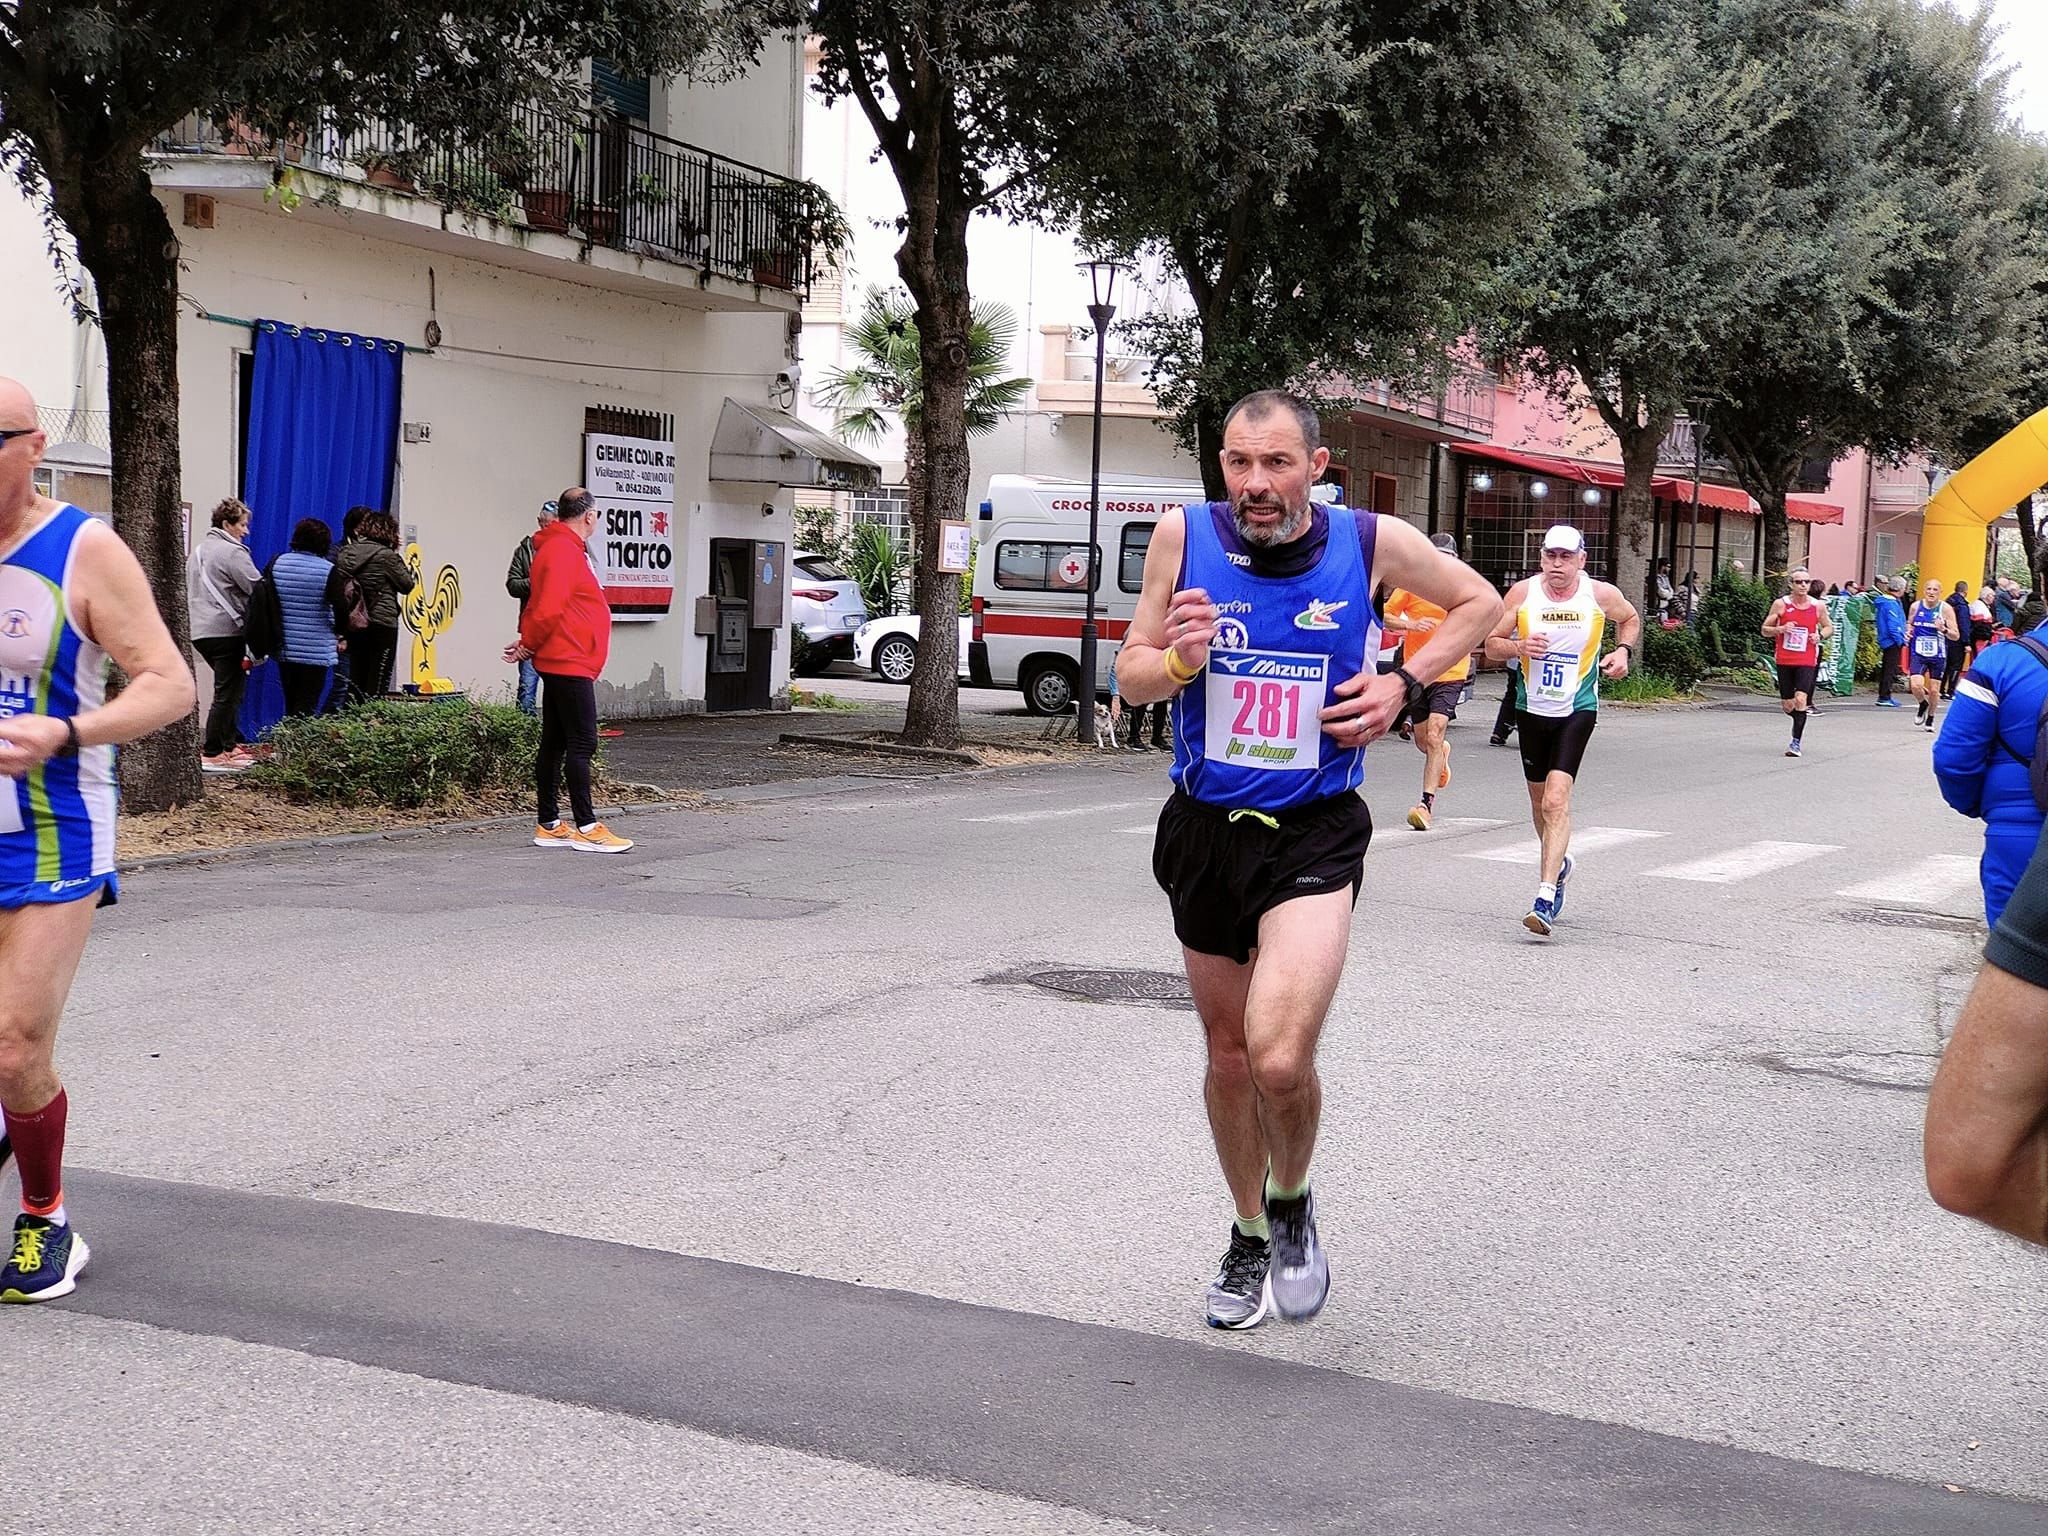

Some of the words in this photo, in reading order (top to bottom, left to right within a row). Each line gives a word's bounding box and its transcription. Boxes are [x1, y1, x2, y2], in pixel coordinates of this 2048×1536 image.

[1052, 500, 1100, 511] CROC
[1106, 501, 1155, 513] ROSSA
[606, 508, 643, 537] san
[607, 541, 672, 570] marco
[1541, 613, 1579, 622] MAMELI
[1542, 662, 1564, 688] 55
[1231, 680, 1300, 739] 281
